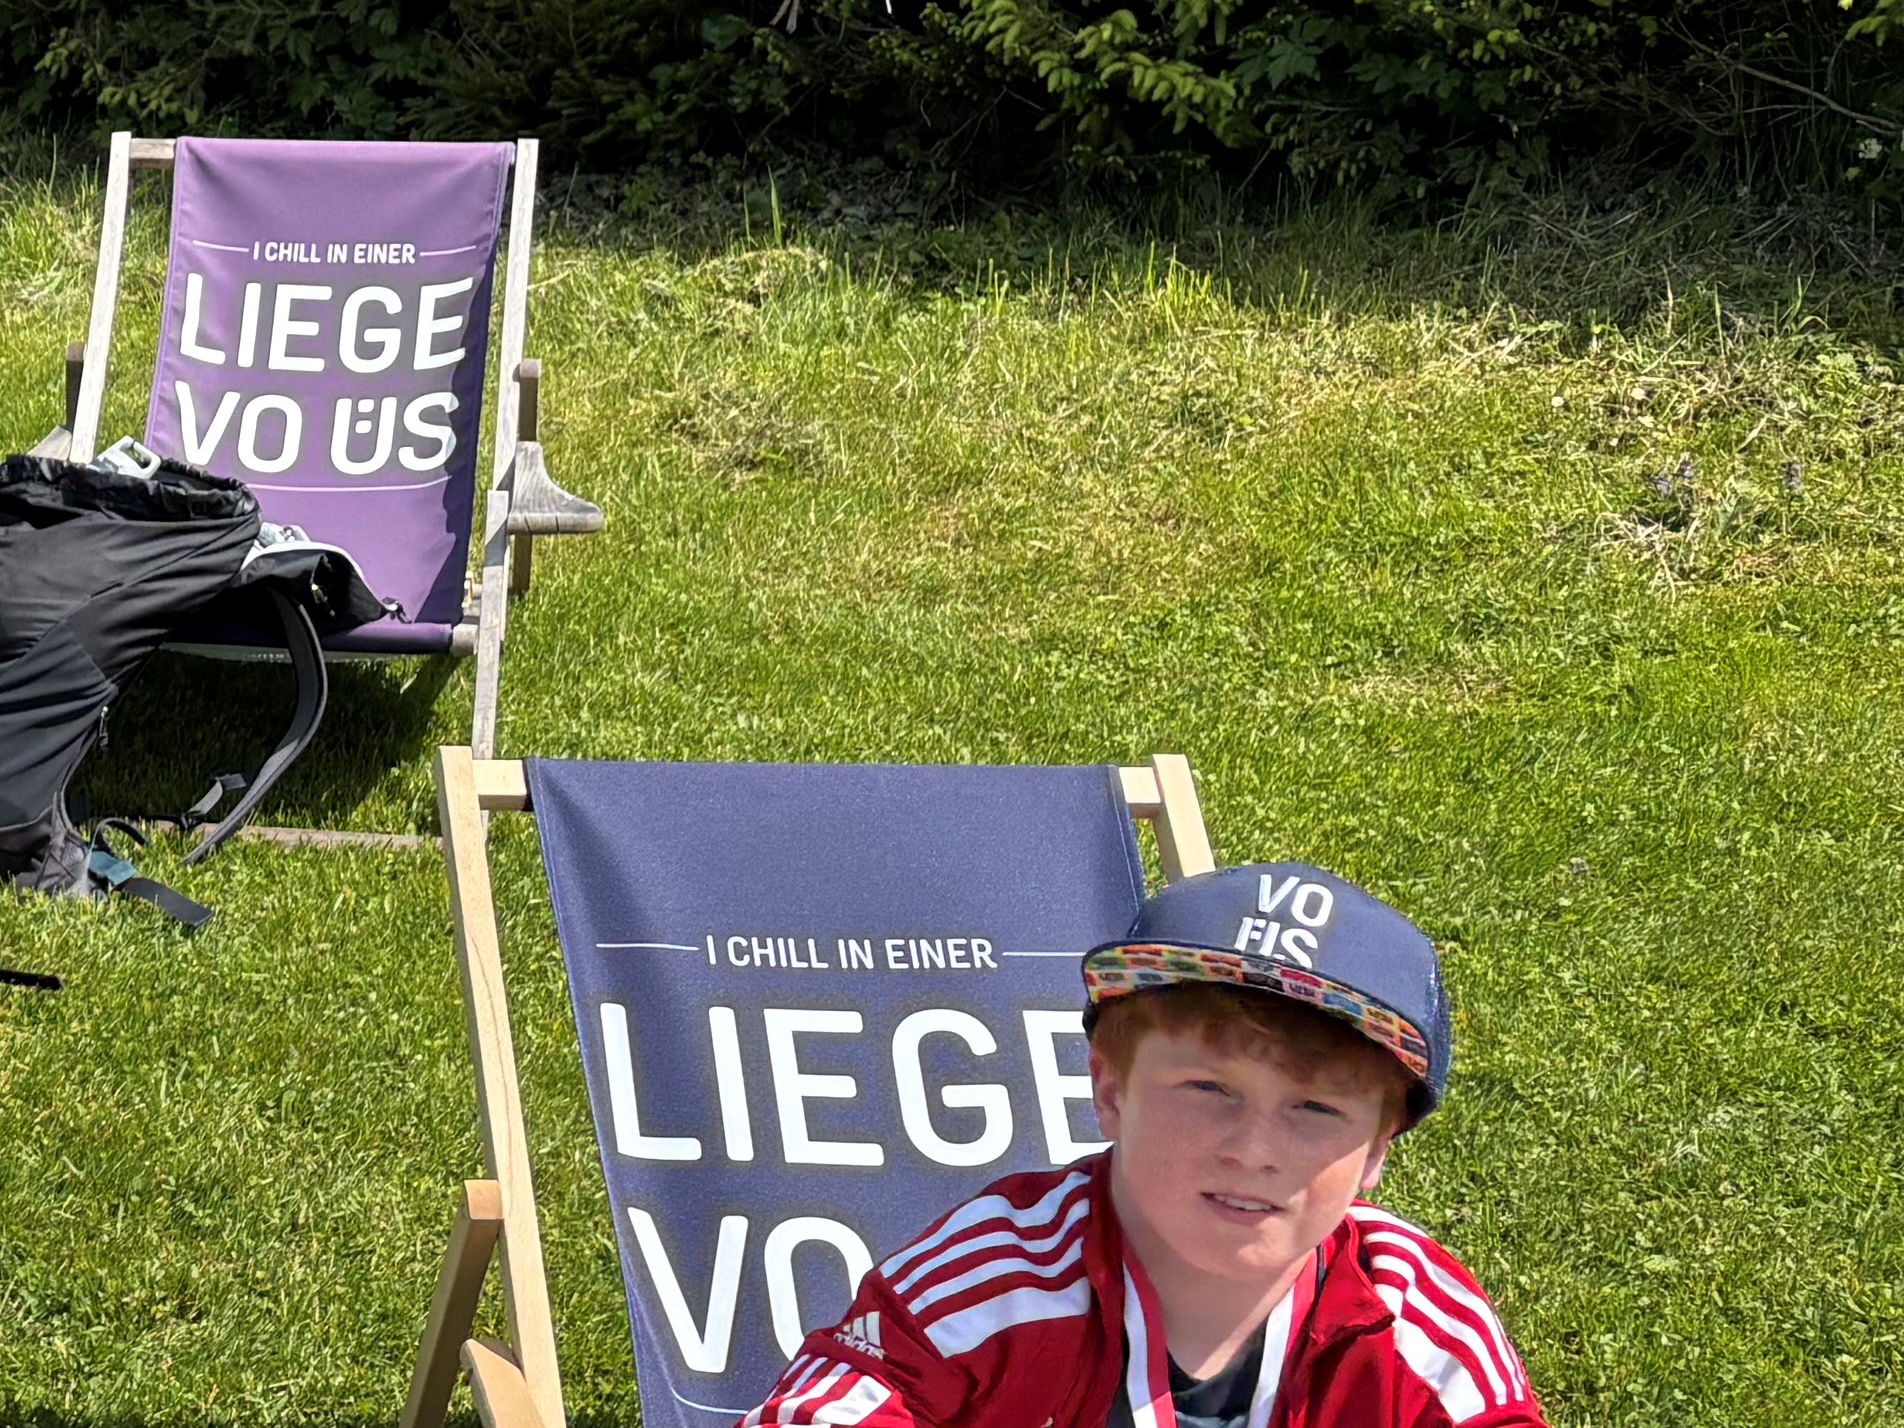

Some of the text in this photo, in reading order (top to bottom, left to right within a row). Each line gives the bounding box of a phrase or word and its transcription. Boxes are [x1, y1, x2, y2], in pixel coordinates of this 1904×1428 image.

[253, 241, 416, 264] I CHILL IN EINER
[180, 272, 474, 373] LIEGE
[175, 380, 460, 475] VO ÜS
[1258, 874, 1334, 927] VO
[706, 935, 998, 969] I CHILL IN EINER
[600, 1002, 1114, 1166] LIEGE
